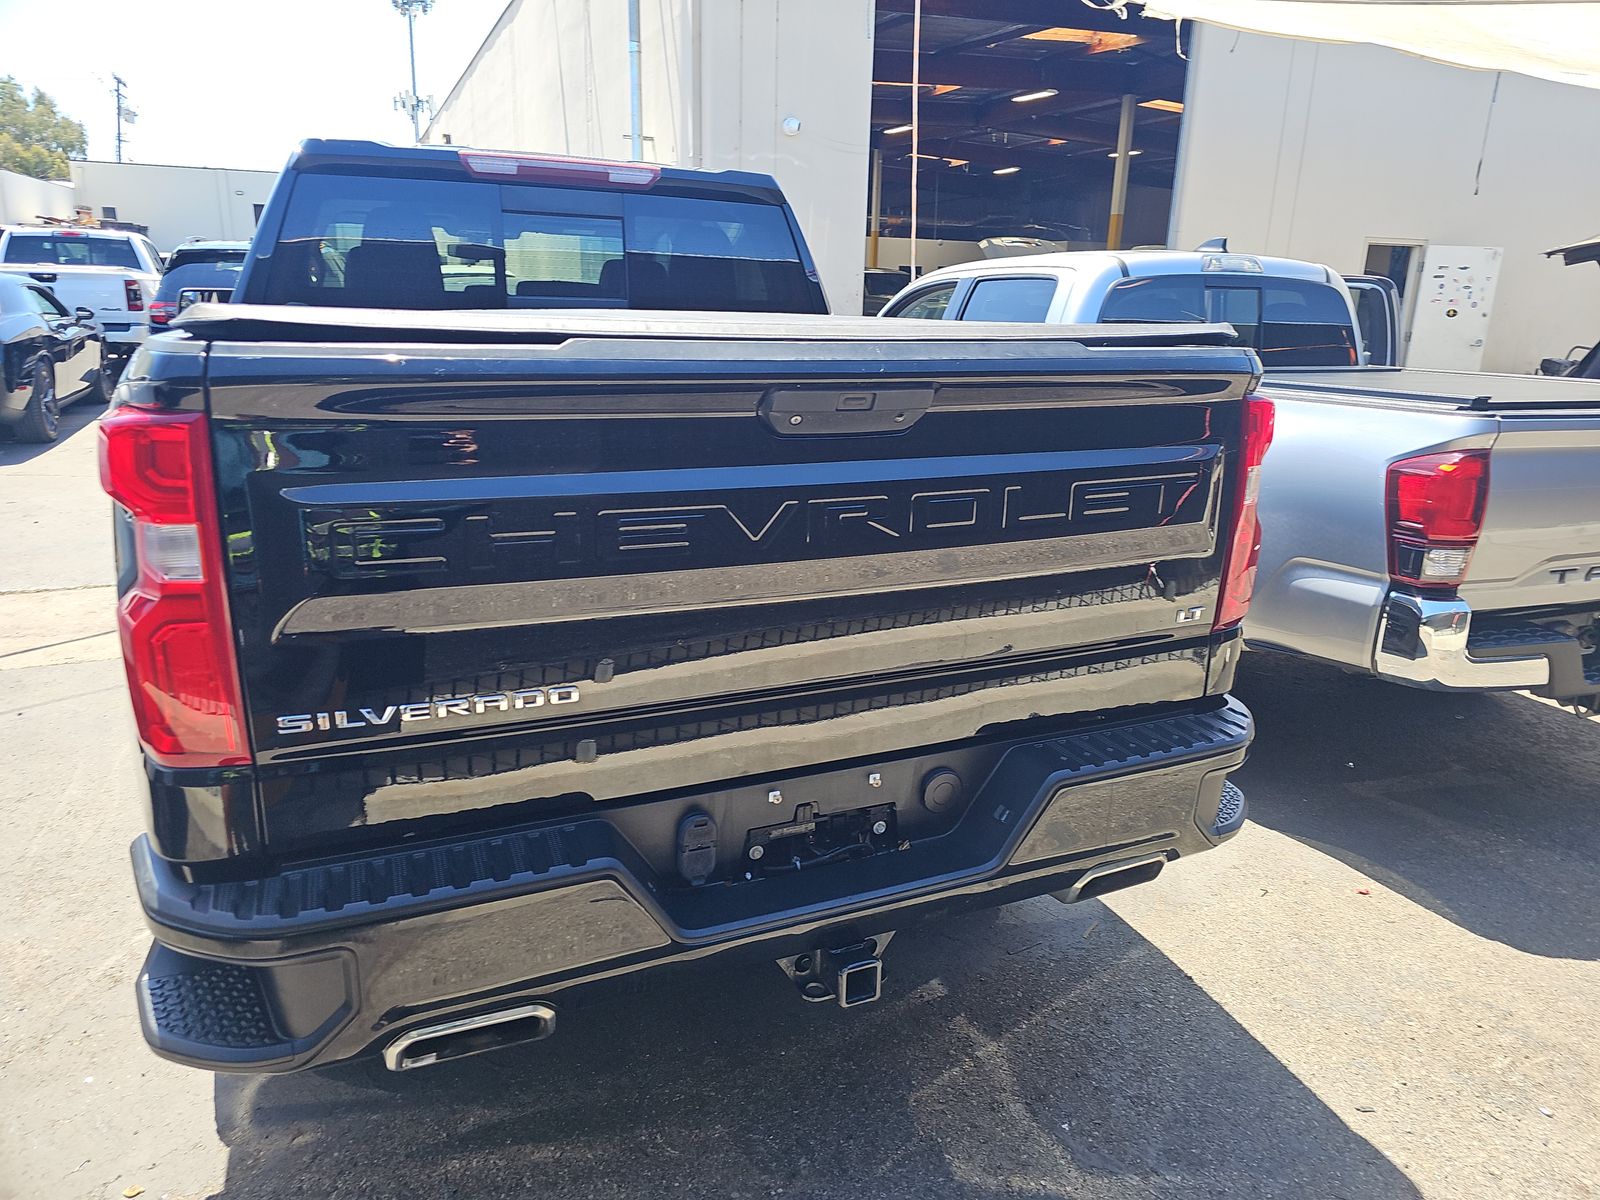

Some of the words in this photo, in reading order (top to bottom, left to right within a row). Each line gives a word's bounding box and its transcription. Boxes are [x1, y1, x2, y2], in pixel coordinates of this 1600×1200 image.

[329, 471, 1200, 580] CHEVROLET
[1175, 605, 1206, 623] LT
[276, 685, 580, 735] SILVERADO
